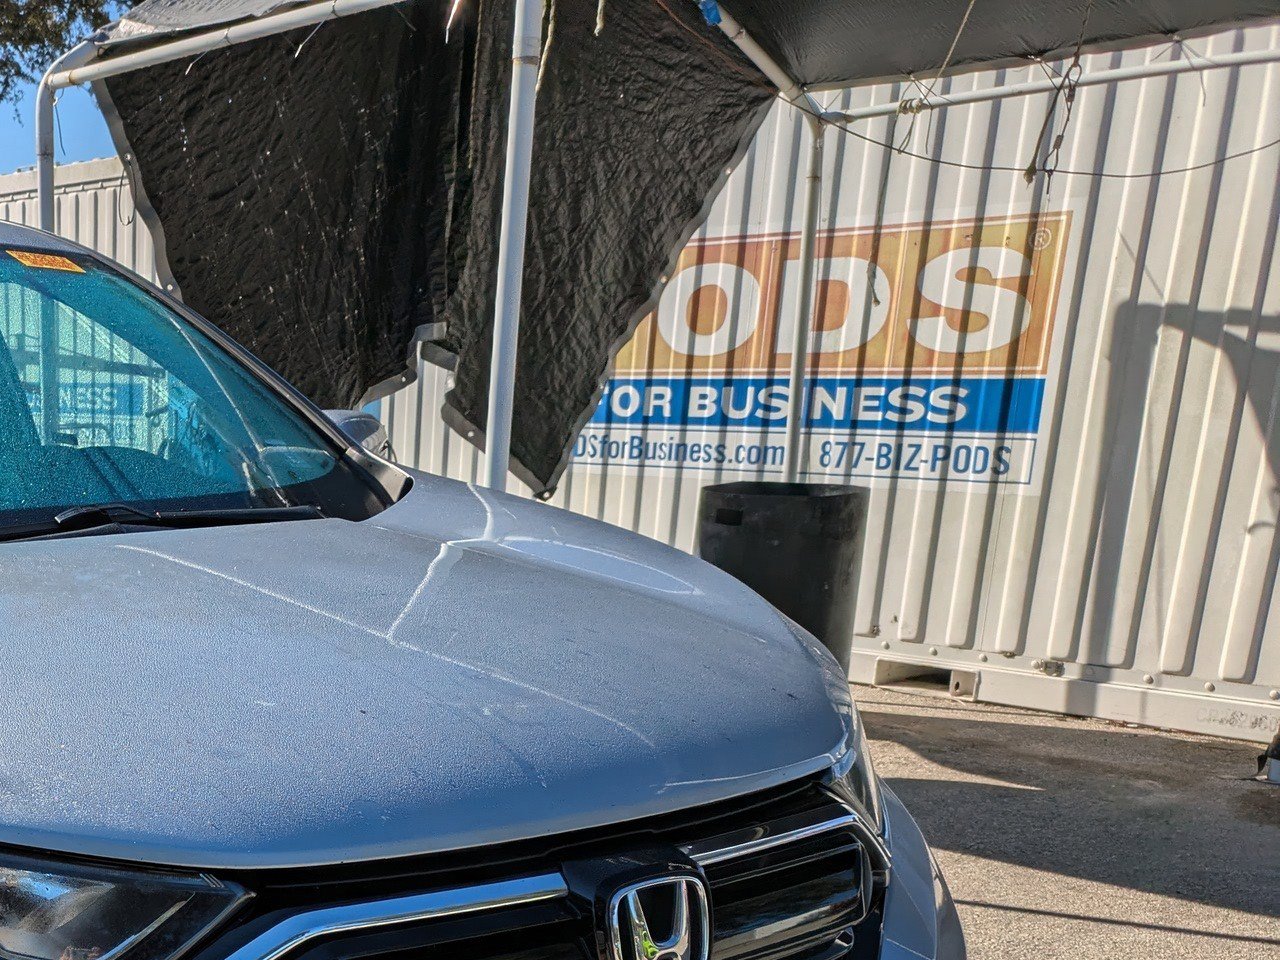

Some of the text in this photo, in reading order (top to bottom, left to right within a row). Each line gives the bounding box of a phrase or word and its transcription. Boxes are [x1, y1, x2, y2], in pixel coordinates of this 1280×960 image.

[658, 246, 1033, 356] ODS
[598, 385, 969, 423] OR BUSNESS
[573, 433, 785, 466] DSforBusiness.com
[819, 440, 1011, 476] 877-BIZ-PODS
